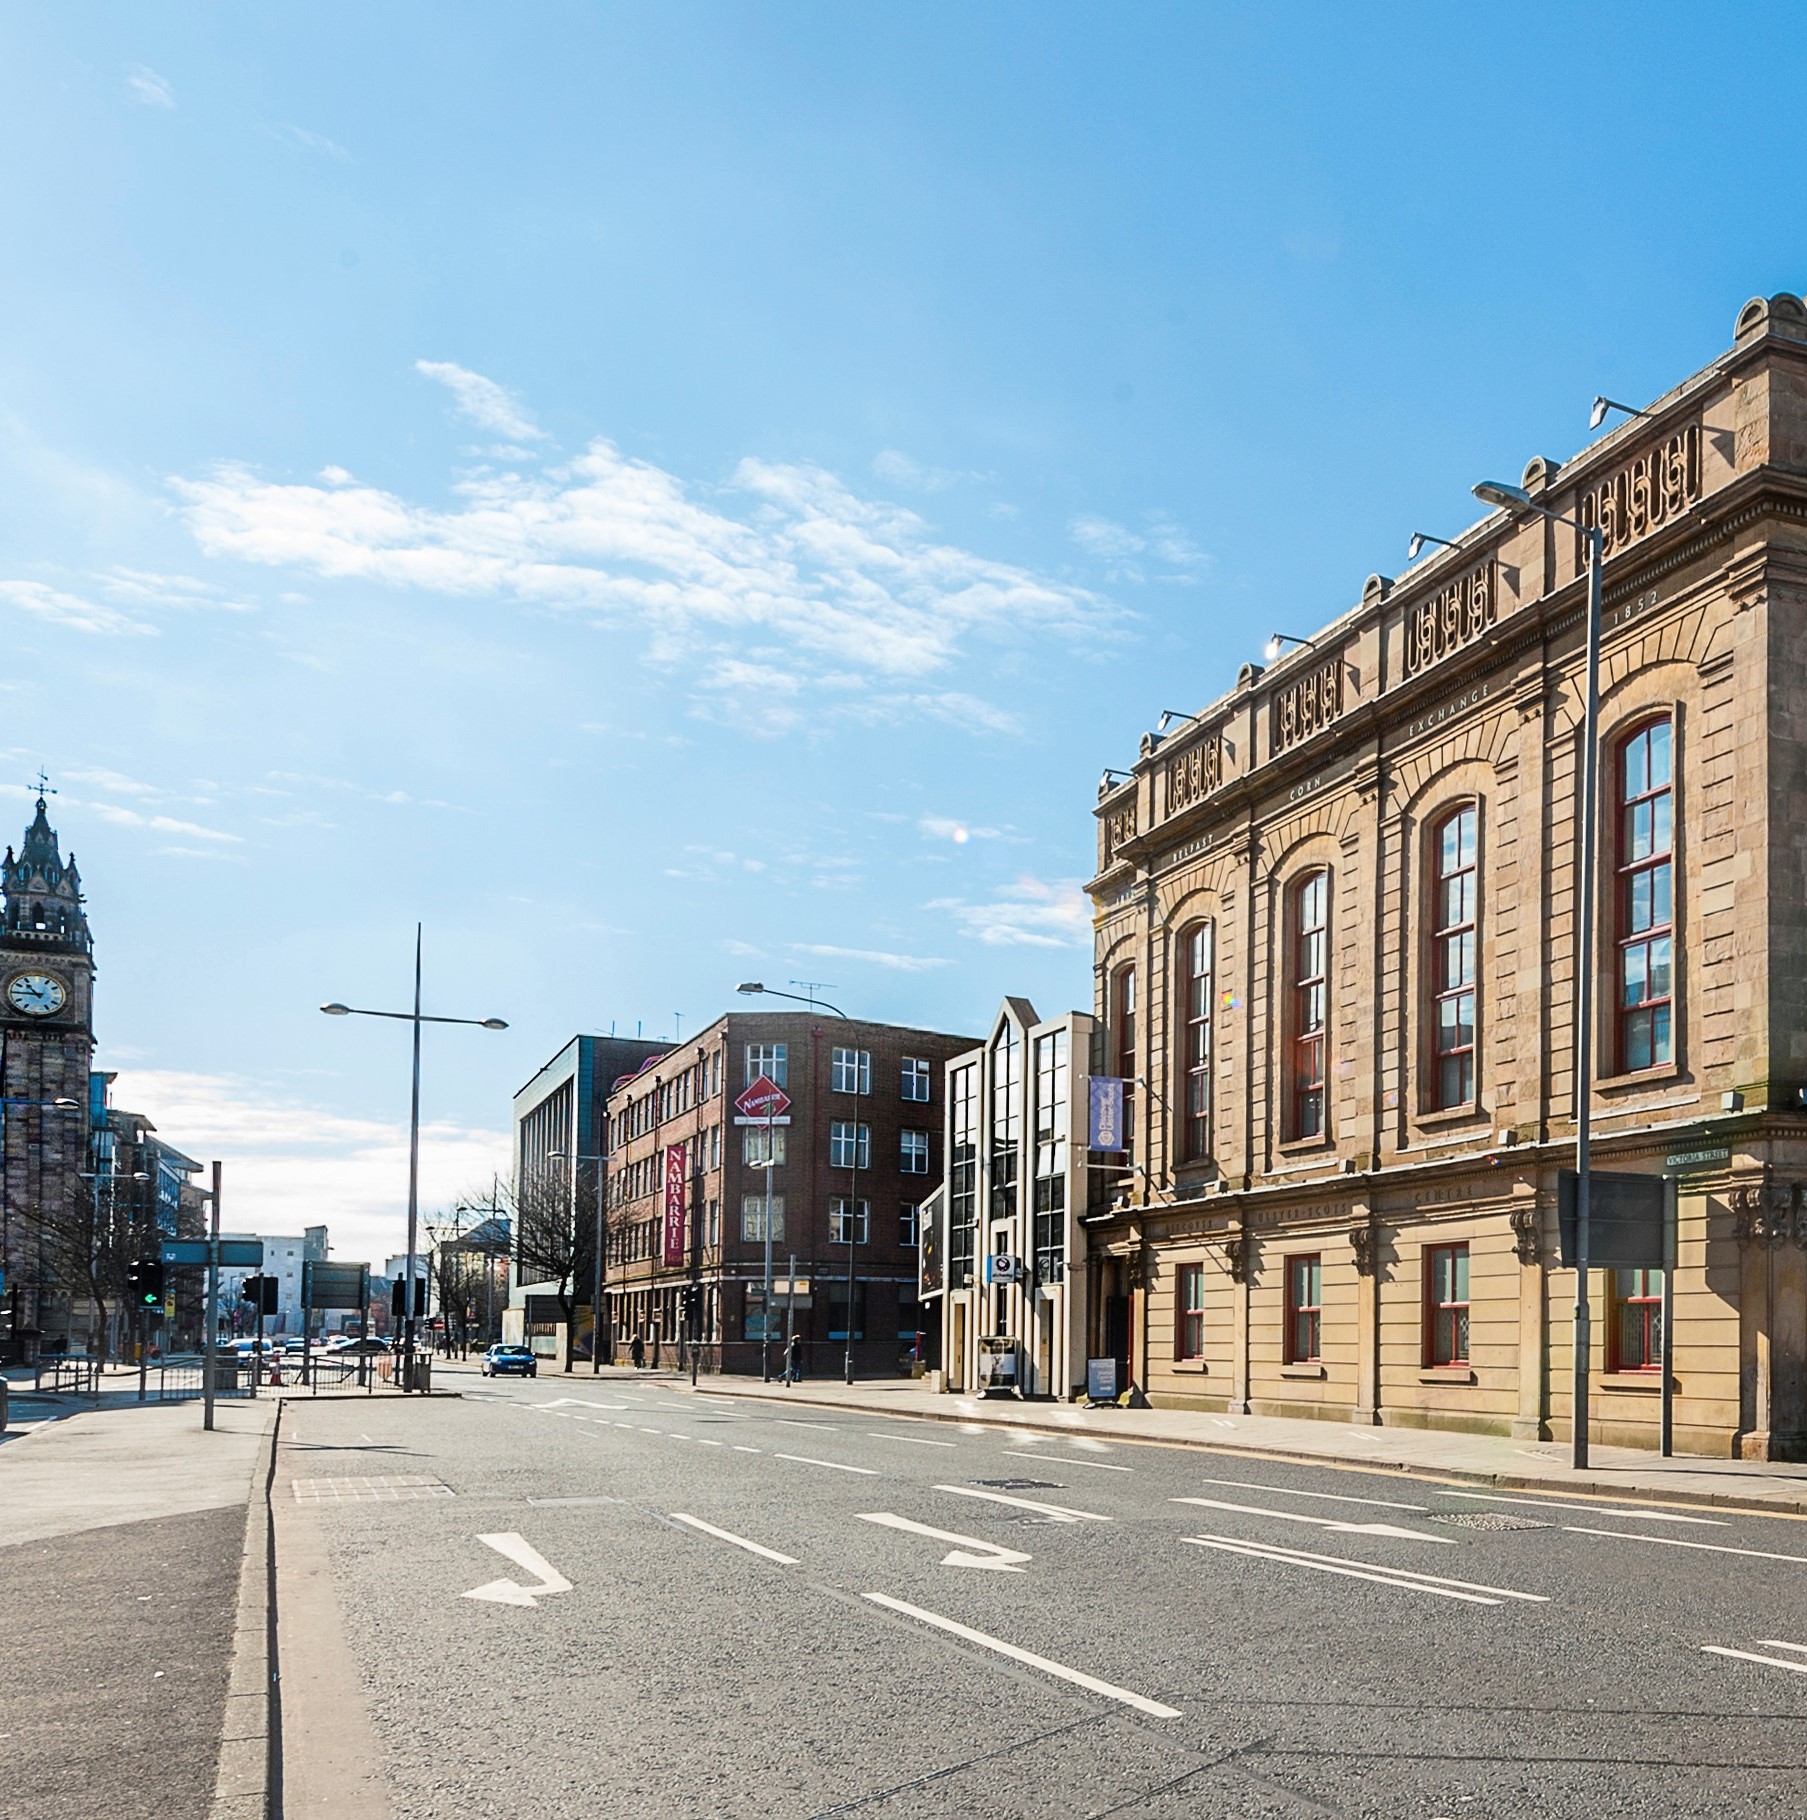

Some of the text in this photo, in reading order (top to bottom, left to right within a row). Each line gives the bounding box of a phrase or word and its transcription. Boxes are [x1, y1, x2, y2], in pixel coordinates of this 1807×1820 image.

[1173, 834, 1213, 862] BELFAST
[1290, 777, 1321, 800] CORN
[1409, 684, 1489, 737] EXCHANGE
[1614, 590, 1657, 625] 1852
[1702, 1149, 1727, 1160] STREET
[668, 1150, 683, 1249] NAMBARRIE
[1258, 1203, 1347, 1222] ULSTER-SCOTS
